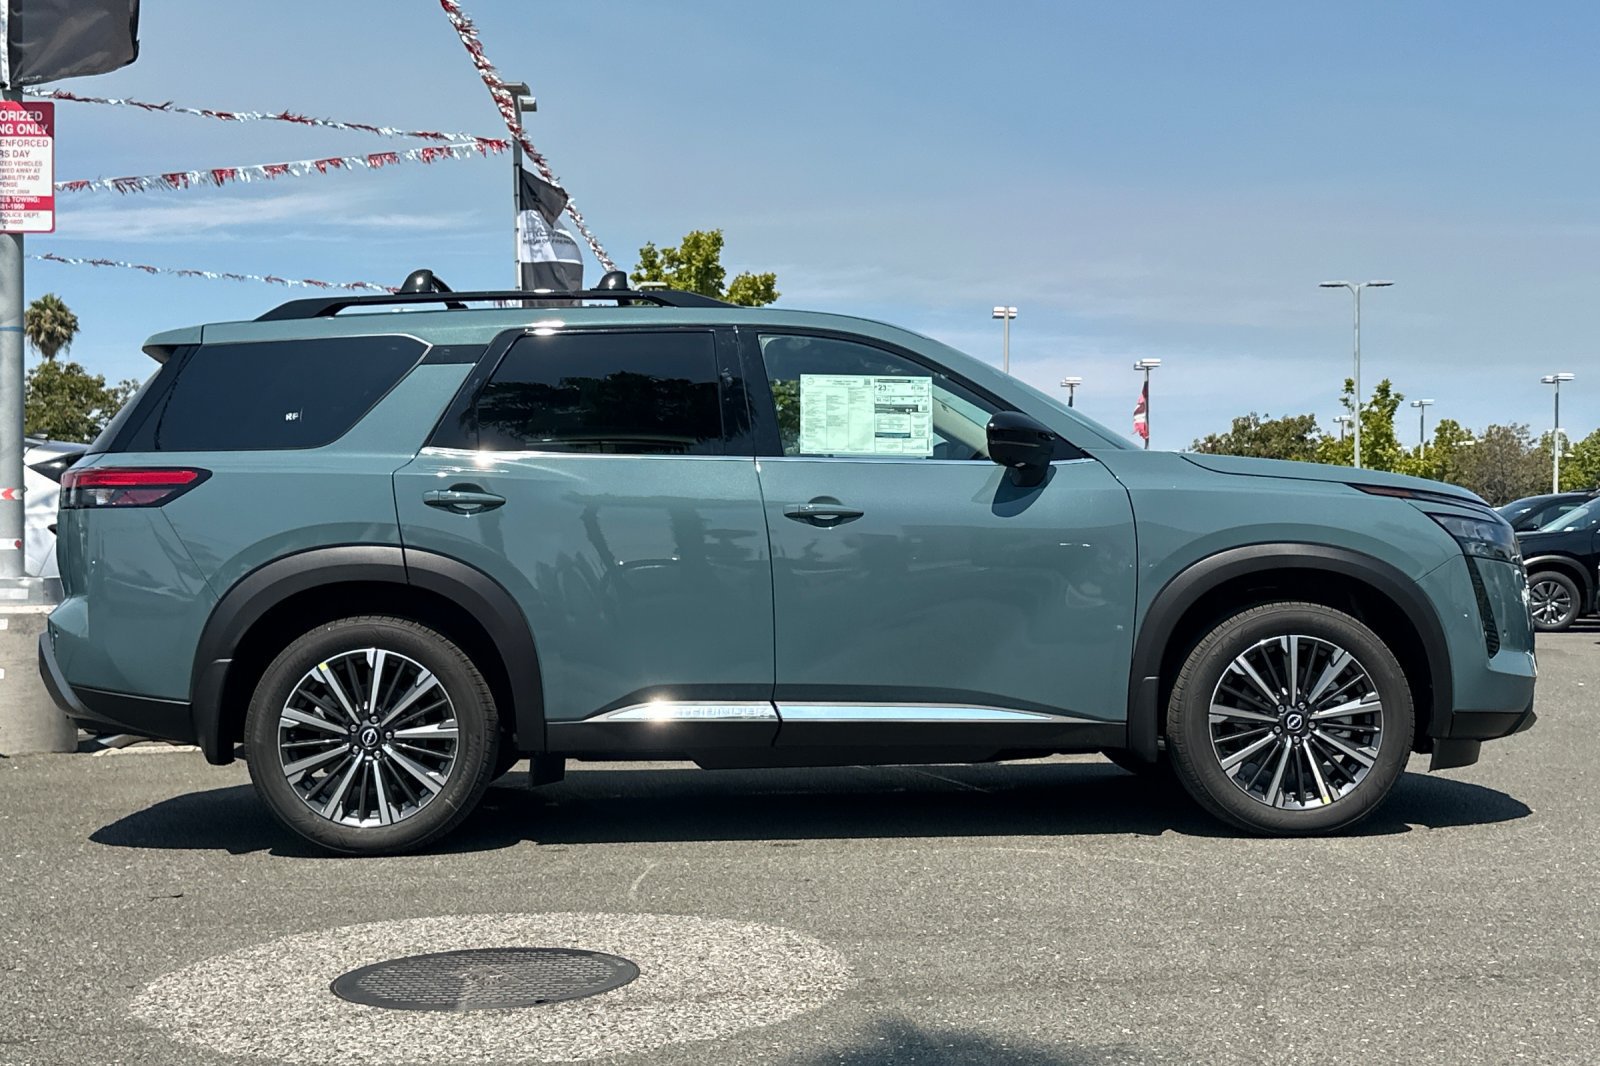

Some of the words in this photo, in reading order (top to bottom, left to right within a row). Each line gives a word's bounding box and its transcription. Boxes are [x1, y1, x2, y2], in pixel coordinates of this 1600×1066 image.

[16, 123, 48, 135] ONLY
[0, 139, 49, 148] ENFORCED
[12, 150, 31, 158] DAY
